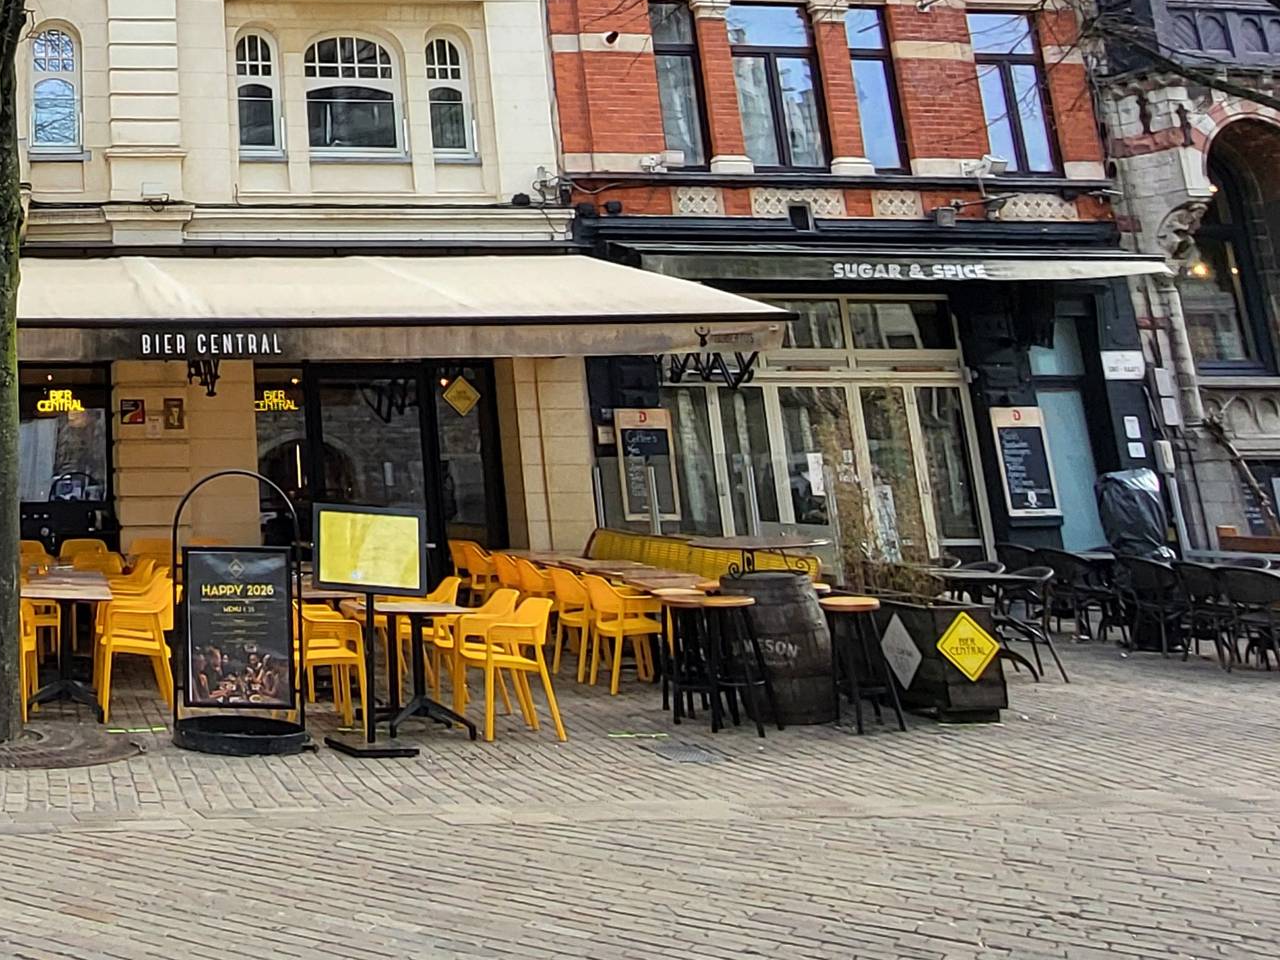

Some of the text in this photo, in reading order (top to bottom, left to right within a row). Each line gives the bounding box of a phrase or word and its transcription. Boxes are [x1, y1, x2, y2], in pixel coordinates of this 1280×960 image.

[833, 263, 988, 279] SUGAR & SPICE
[141, 333, 282, 355] BIER CENTRAL
[50, 390, 72, 401] BIER
[264, 390, 285, 401] BIER
[37, 400, 85, 411] CENTRAL
[201, 584, 274, 596] HAPPY 2026
[950, 646, 986, 656] CENTRAL
